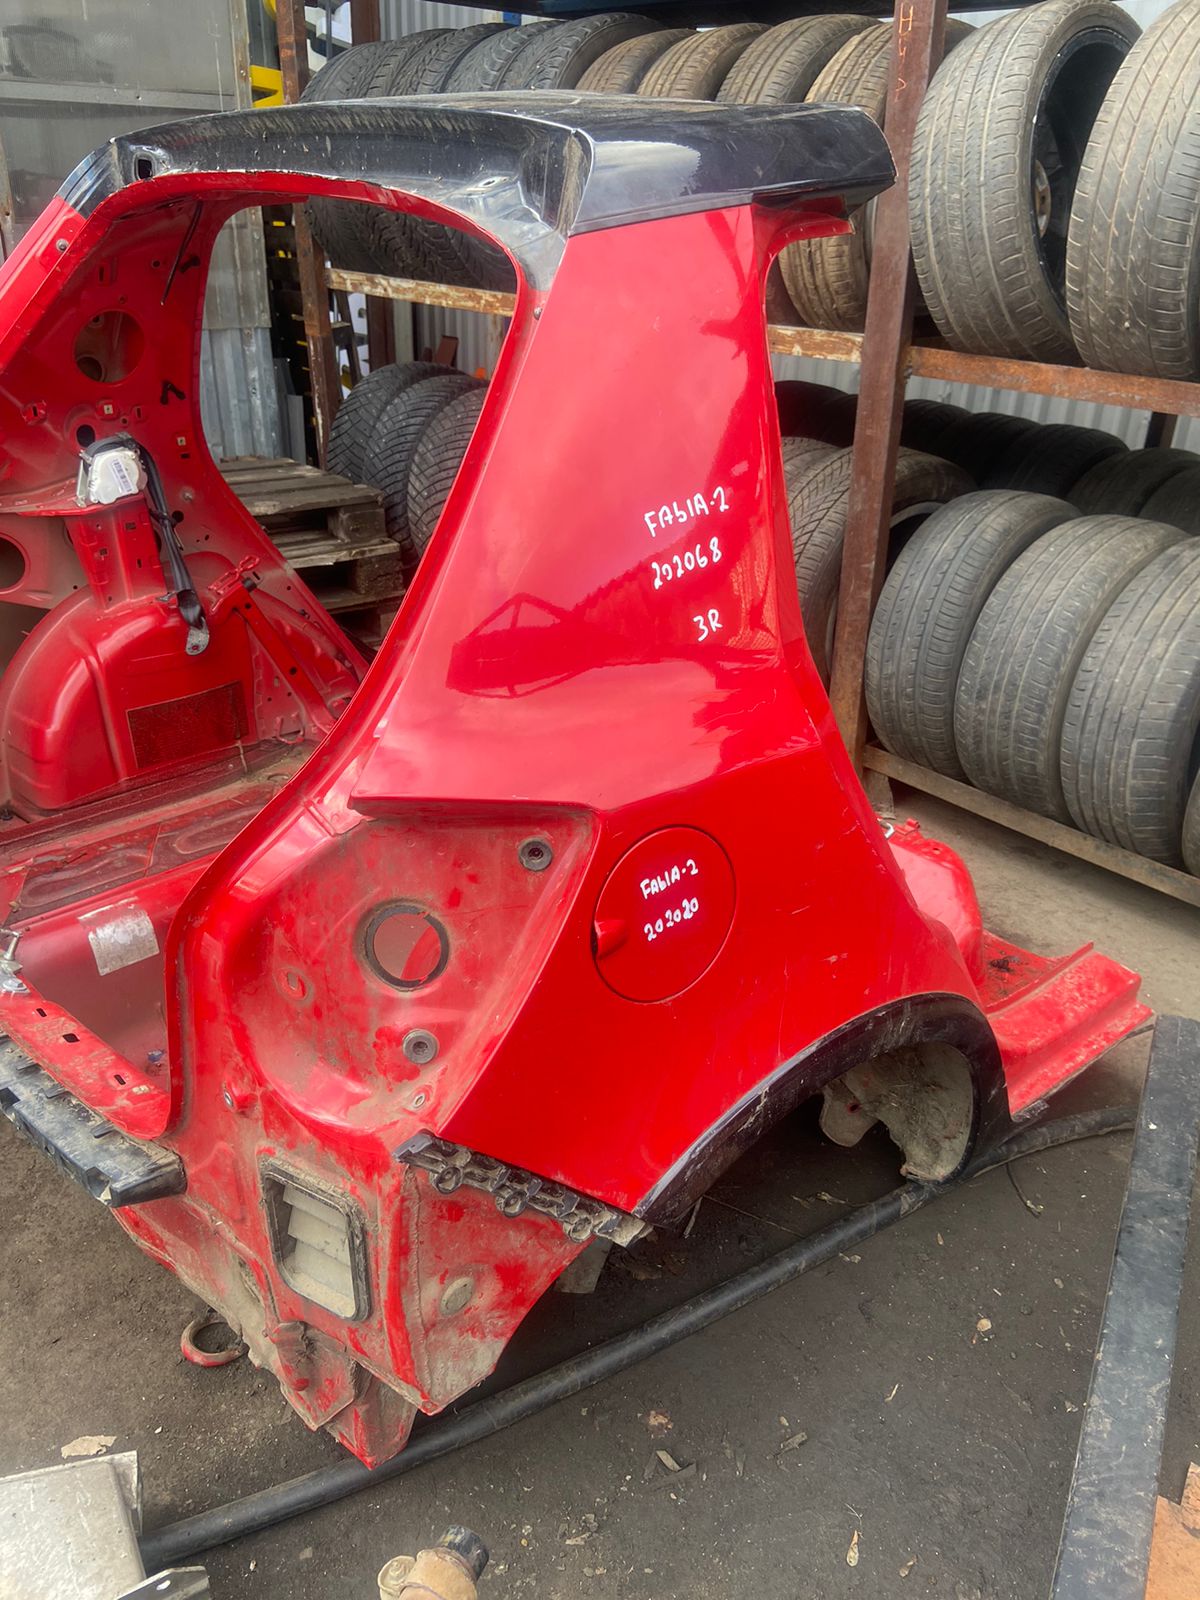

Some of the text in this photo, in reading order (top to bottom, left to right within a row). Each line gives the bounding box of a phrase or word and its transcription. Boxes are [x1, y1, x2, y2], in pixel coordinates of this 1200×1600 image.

[651, 536, 722, 590] 202068
[693, 609, 723, 642] 3R
[643, 896, 699, 942] 202020
